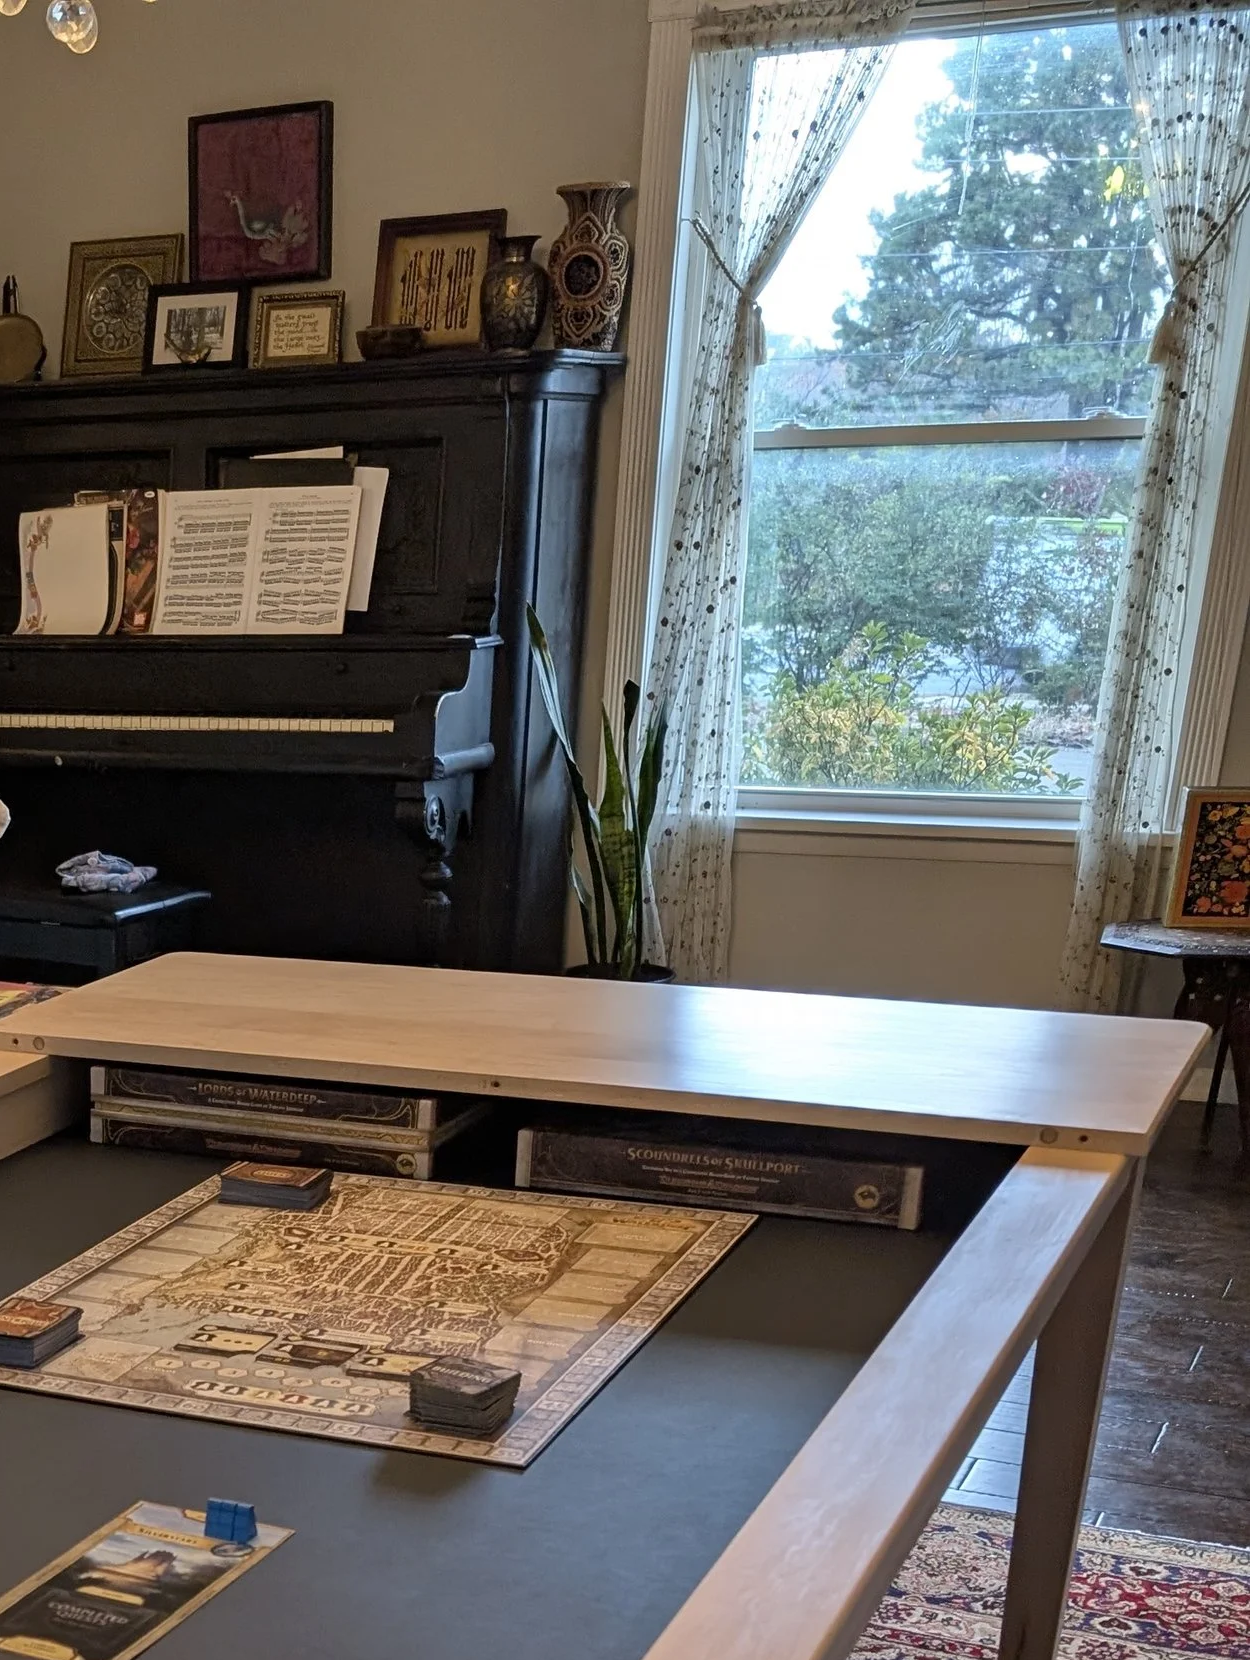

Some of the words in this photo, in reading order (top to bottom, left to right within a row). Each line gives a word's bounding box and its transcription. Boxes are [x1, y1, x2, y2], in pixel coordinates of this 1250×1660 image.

[198, 1082, 234, 1096] LORDS
[248, 1087, 317, 1105] WATERDEEP
[627, 1147, 710, 1166] SCOUNDRELS
[724, 1156, 801, 1175] SKULLPORT
